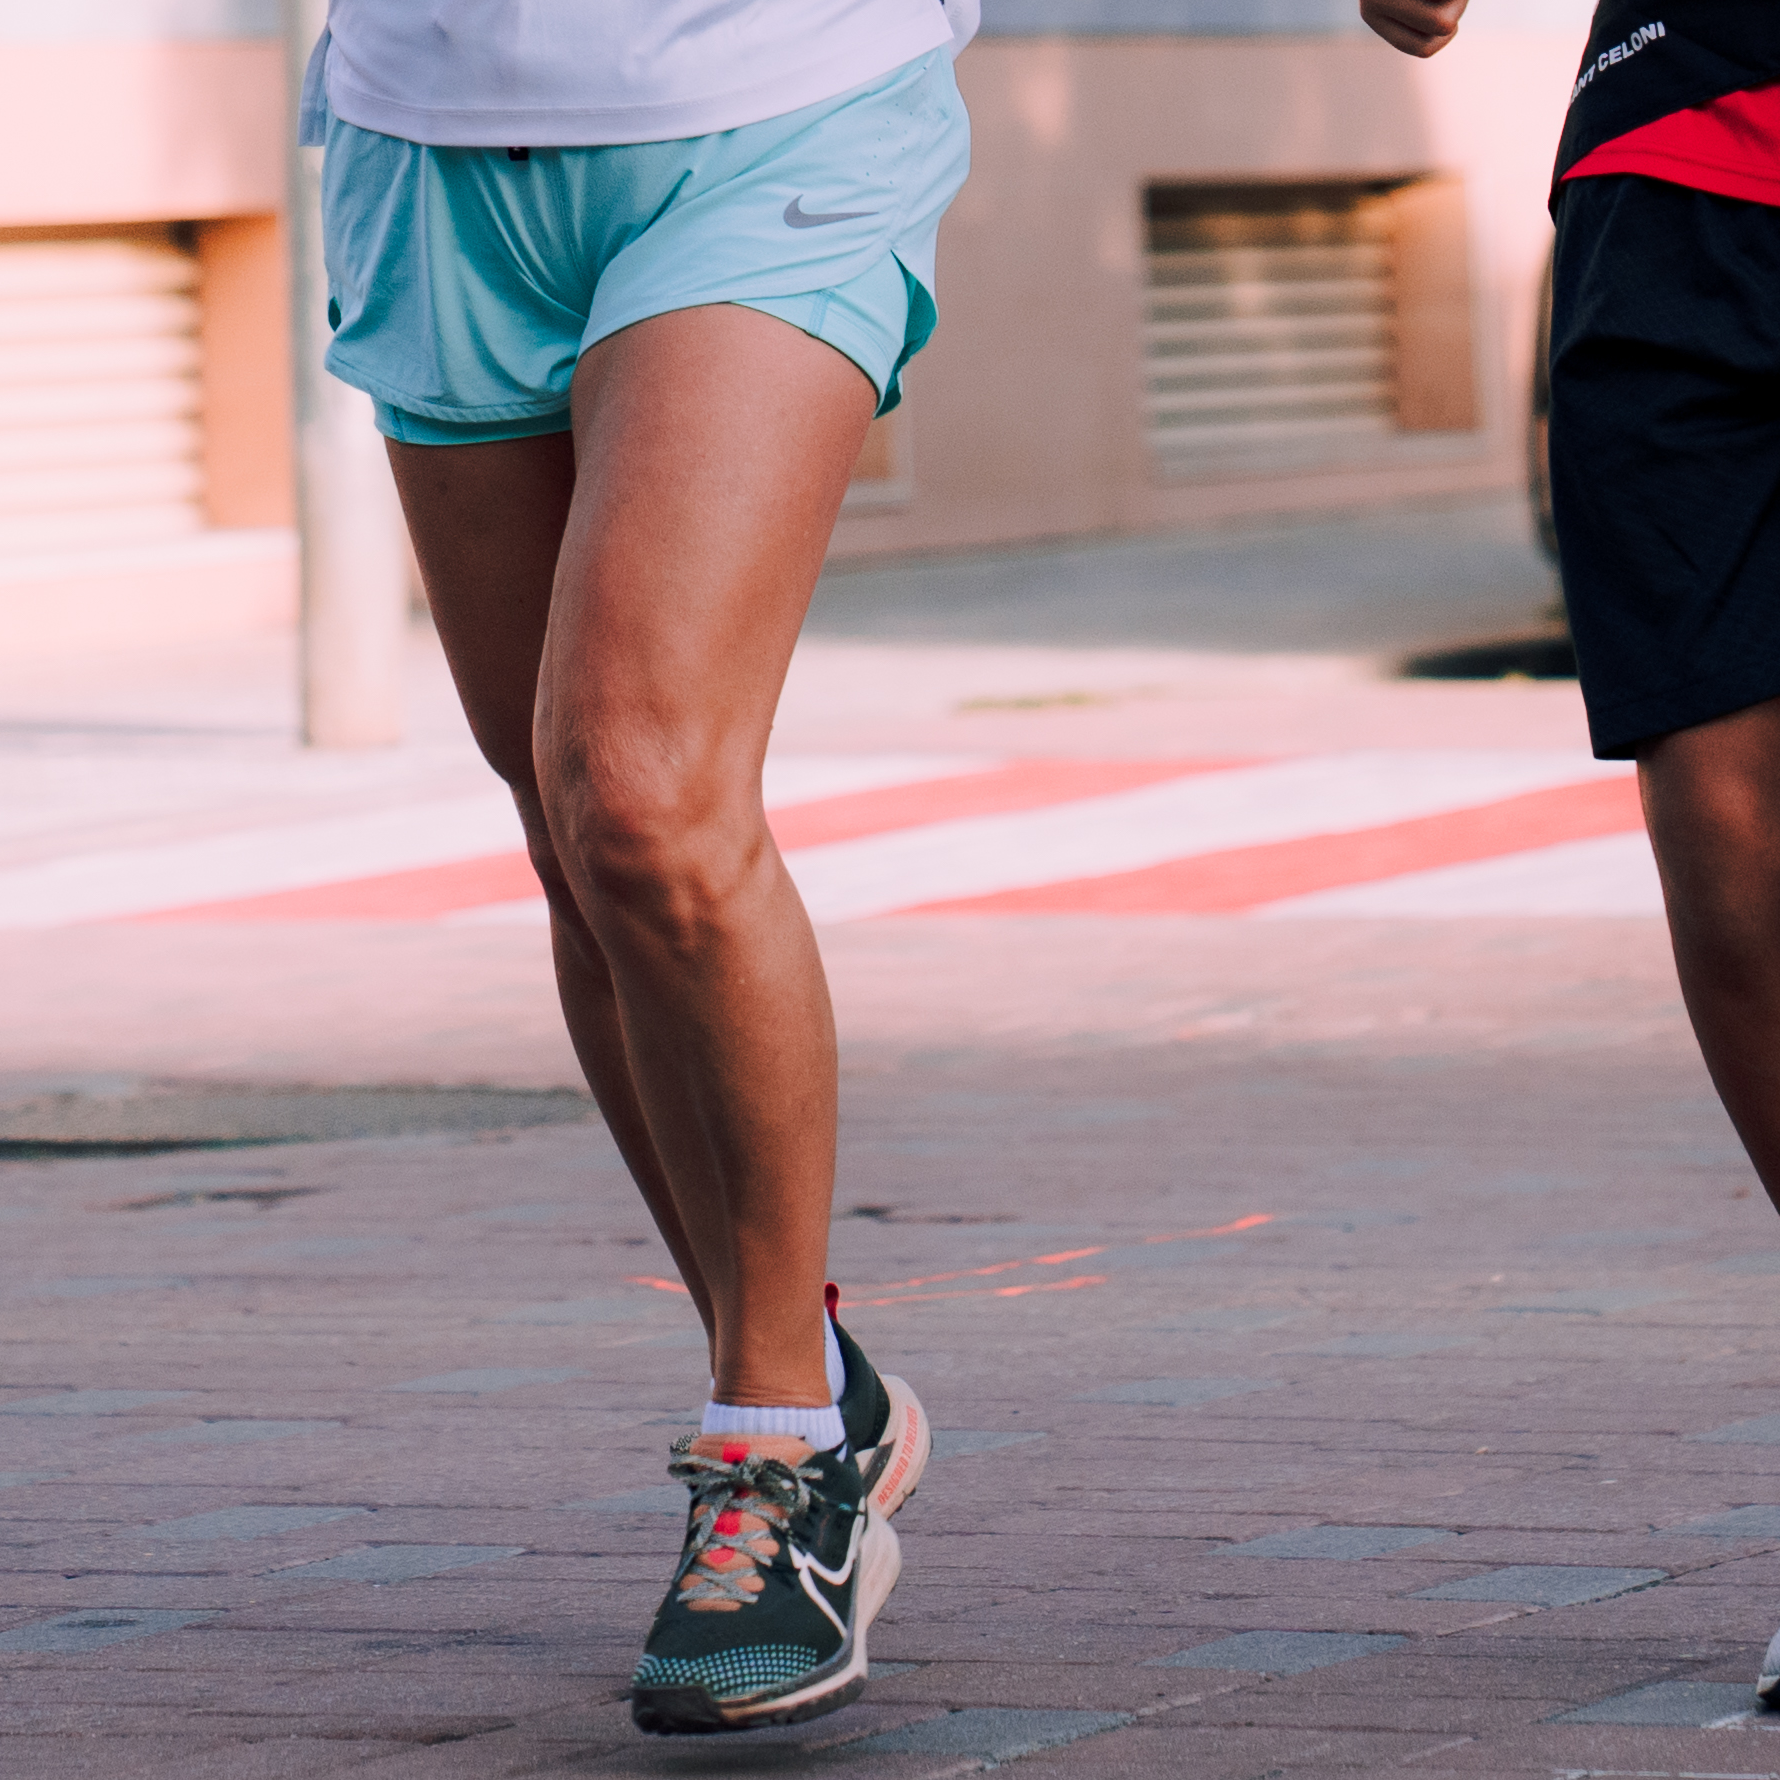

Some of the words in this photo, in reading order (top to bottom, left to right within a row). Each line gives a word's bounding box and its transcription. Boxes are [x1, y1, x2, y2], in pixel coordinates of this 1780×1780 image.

[1570, 63, 1596, 104] ANT
[1597, 21, 1666, 71] CELONI
[877, 1455, 909, 1506] DESIGNED
[901, 1443, 913, 1459] TO
